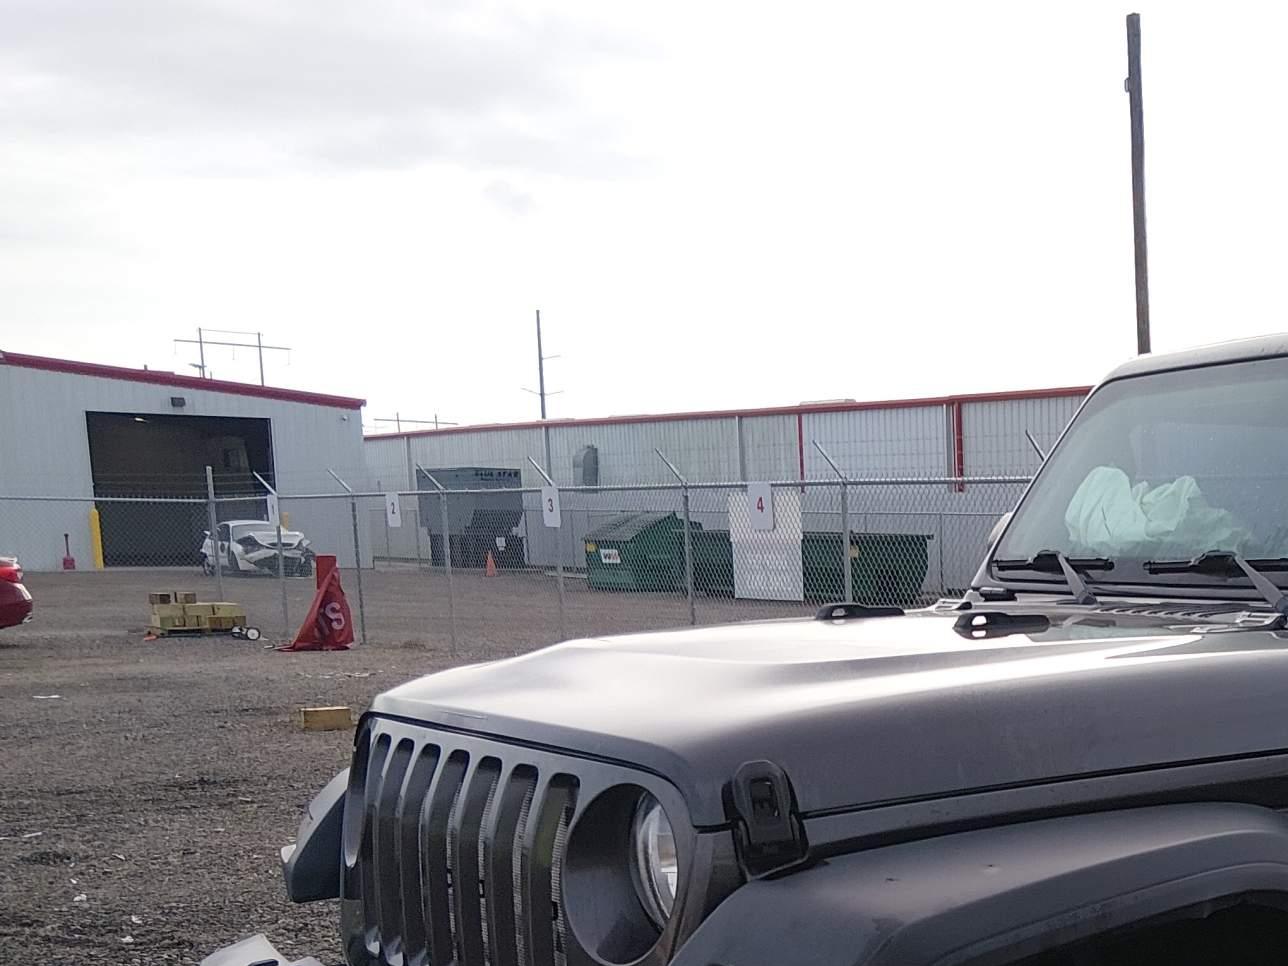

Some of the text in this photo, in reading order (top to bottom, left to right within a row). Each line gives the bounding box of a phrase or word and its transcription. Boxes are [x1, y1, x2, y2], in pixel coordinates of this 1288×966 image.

[390, 501, 397, 515] 2
[547, 497, 554, 513] 3
[756, 496, 765, 513] 4
